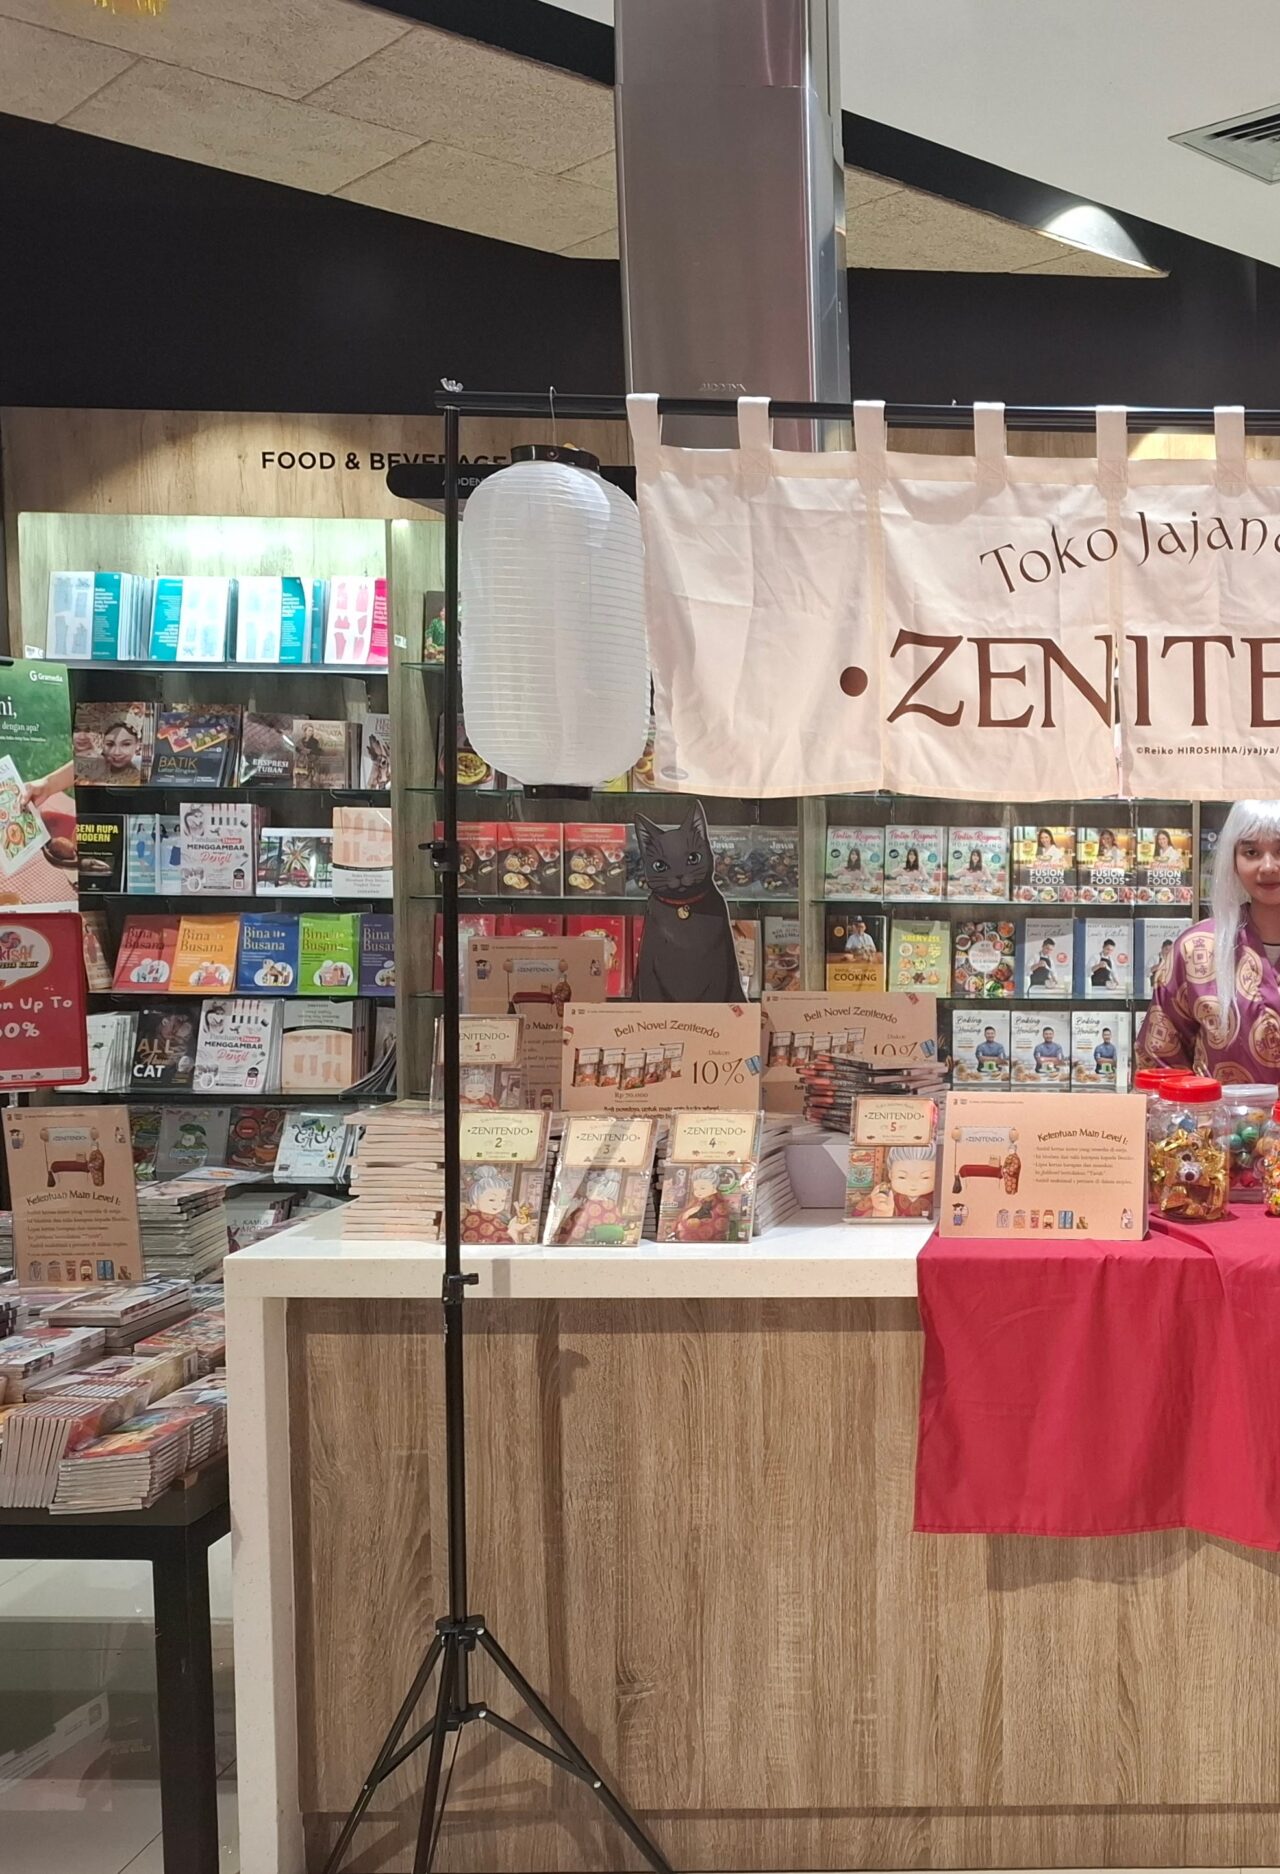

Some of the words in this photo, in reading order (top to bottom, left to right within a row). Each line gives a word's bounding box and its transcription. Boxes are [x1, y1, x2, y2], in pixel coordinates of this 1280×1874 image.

[262, 452, 336, 469] FOOD
[345, 453, 360, 470] &
[979, 525, 1119, 594] Toko
[160, 757, 198, 768] BATIK
[253, 759, 289, 768] EKSPRESI
[257, 766, 284, 774] TUBAN
[75, 824, 95, 833] SENI
[97, 824, 119, 834] RUPA
[1030, 869, 1064, 877] FUSION
[1090, 869, 1124, 877] FUSION
[1147, 877, 1181, 885] FOODS
[129, 928, 152, 938] Bina
[183, 928, 210, 941] Bina
[244, 926, 270, 939] Bina
[302, 927, 330, 939] Bina
[363, 928, 389, 940] Bina
[124, 938, 165, 949] Busana
[180, 941, 224, 952] Busana
[243, 940, 285, 951] Busana
[302, 940, 344, 952] Busana
[834, 973, 877, 981] COOKING
[20, 997, 43, 1013] Up
[51, 996, 73, 1008] To
[803, 1010, 822, 1022] Beli
[824, 1007, 851, 1017] Novel
[853, 1006, 898, 1024] Zenitendo
[614, 1027, 634, 1038] Beli
[636, 1020, 667, 1031] Novel
[670, 1020, 720, 1039] Zenitendo
[459, 1032, 507, 1041] ENITENDO
[137, 1039, 174, 1054] ALL
[205, 1041, 263, 1049] MENGGAMBAR
[133, 1064, 166, 1078] CAT
[693, 1058, 745, 1086] 10%
[867, 1112, 922, 1120] ZENITENDO
[471, 1127, 530, 1136] ZENITENDO
[686, 1127, 744, 1136] ZENITENDO
[890, 1122, 898, 1132] 5
[580, 1133, 638, 1142] ZENITENDO
[1037, 1130, 1077, 1142] Ketentuan
[1080, 1128, 1099, 1138] Main
[1101, 1131, 1122, 1143] Level
[495, 1137, 503, 1148] 2
[709, 1137, 717, 1148] 4
[603, 1144, 611, 1154] 3
[26, 1192, 67, 1206] Ketentuan
[69, 1190, 91, 1200] Main
[93, 1192, 115, 1204] Level
